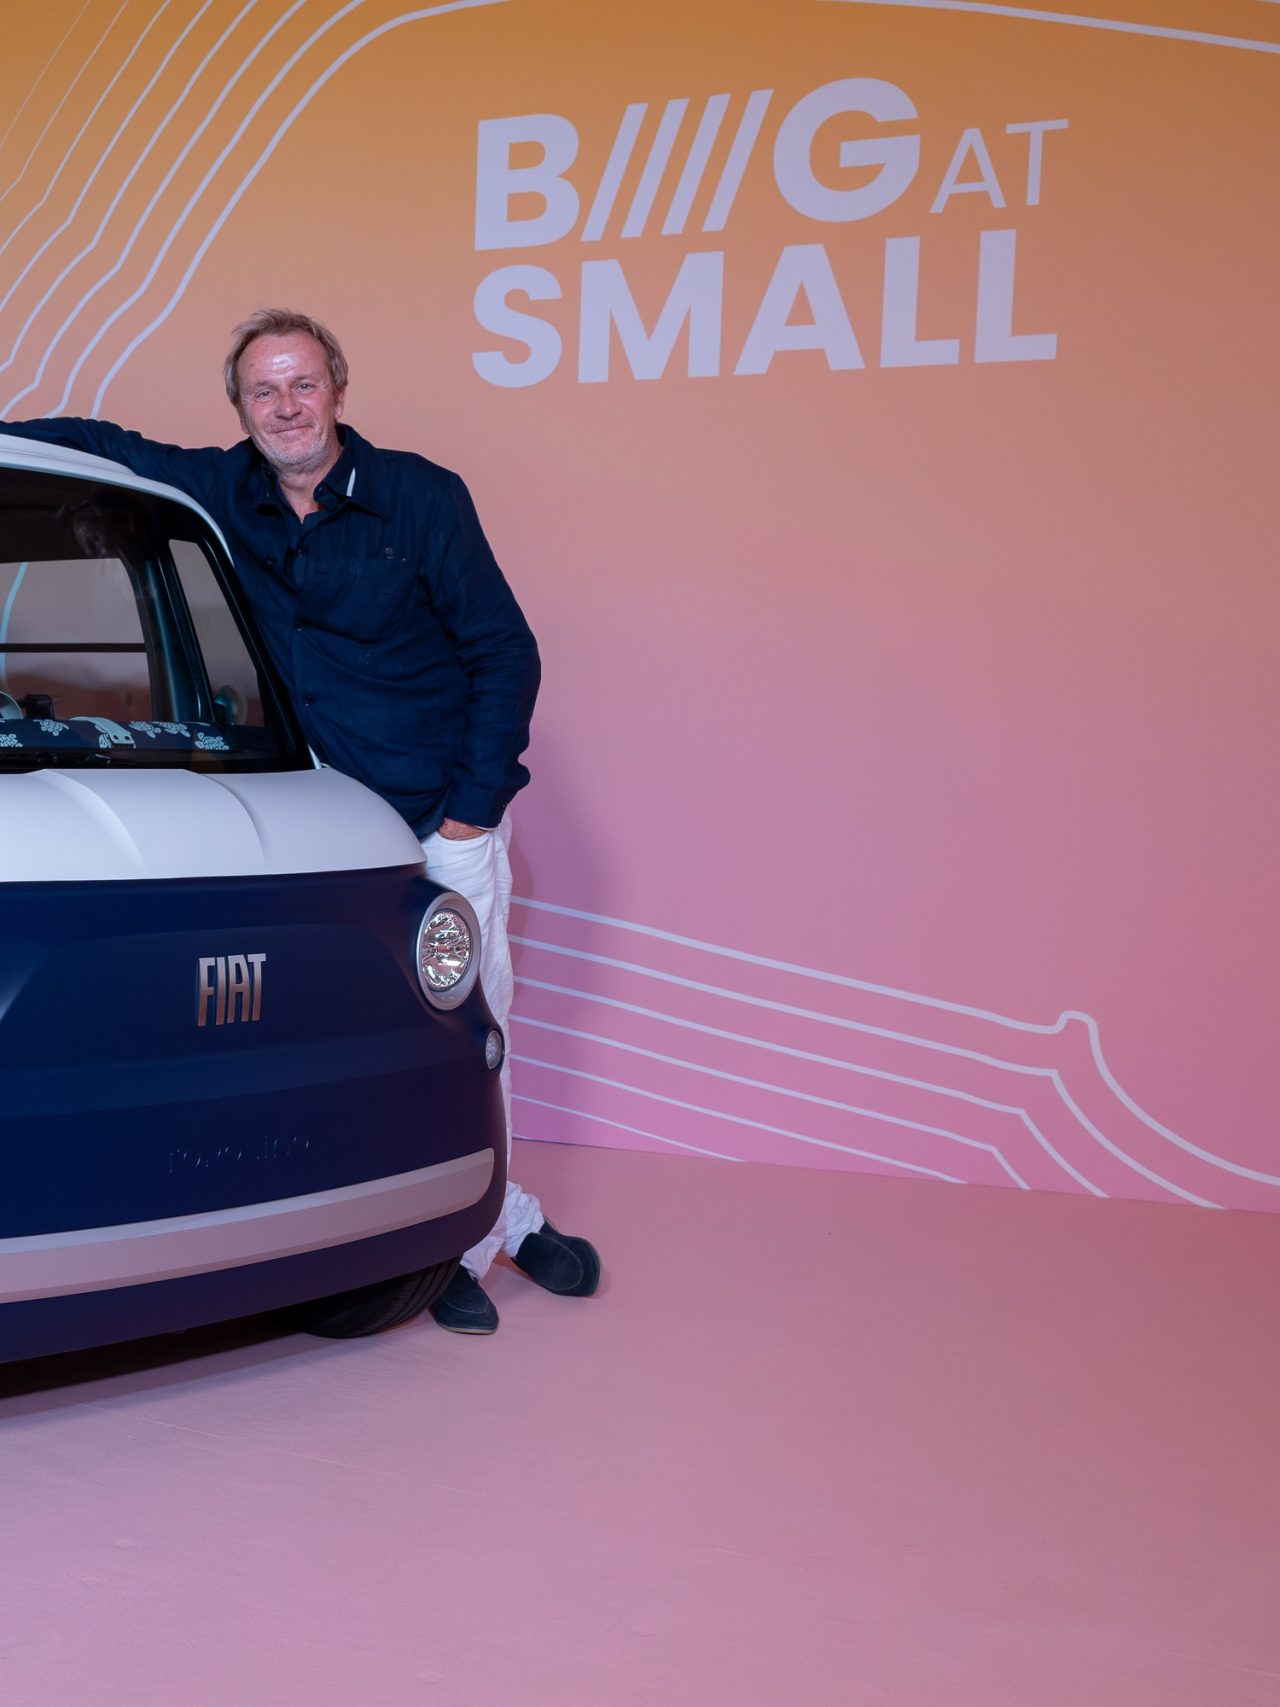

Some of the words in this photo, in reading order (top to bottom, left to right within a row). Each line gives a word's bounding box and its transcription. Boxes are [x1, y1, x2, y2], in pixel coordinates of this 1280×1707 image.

[930, 119, 1069, 214] AT
[472, 229, 1058, 388] SMALL
[198, 953, 266, 1027] FIAT
